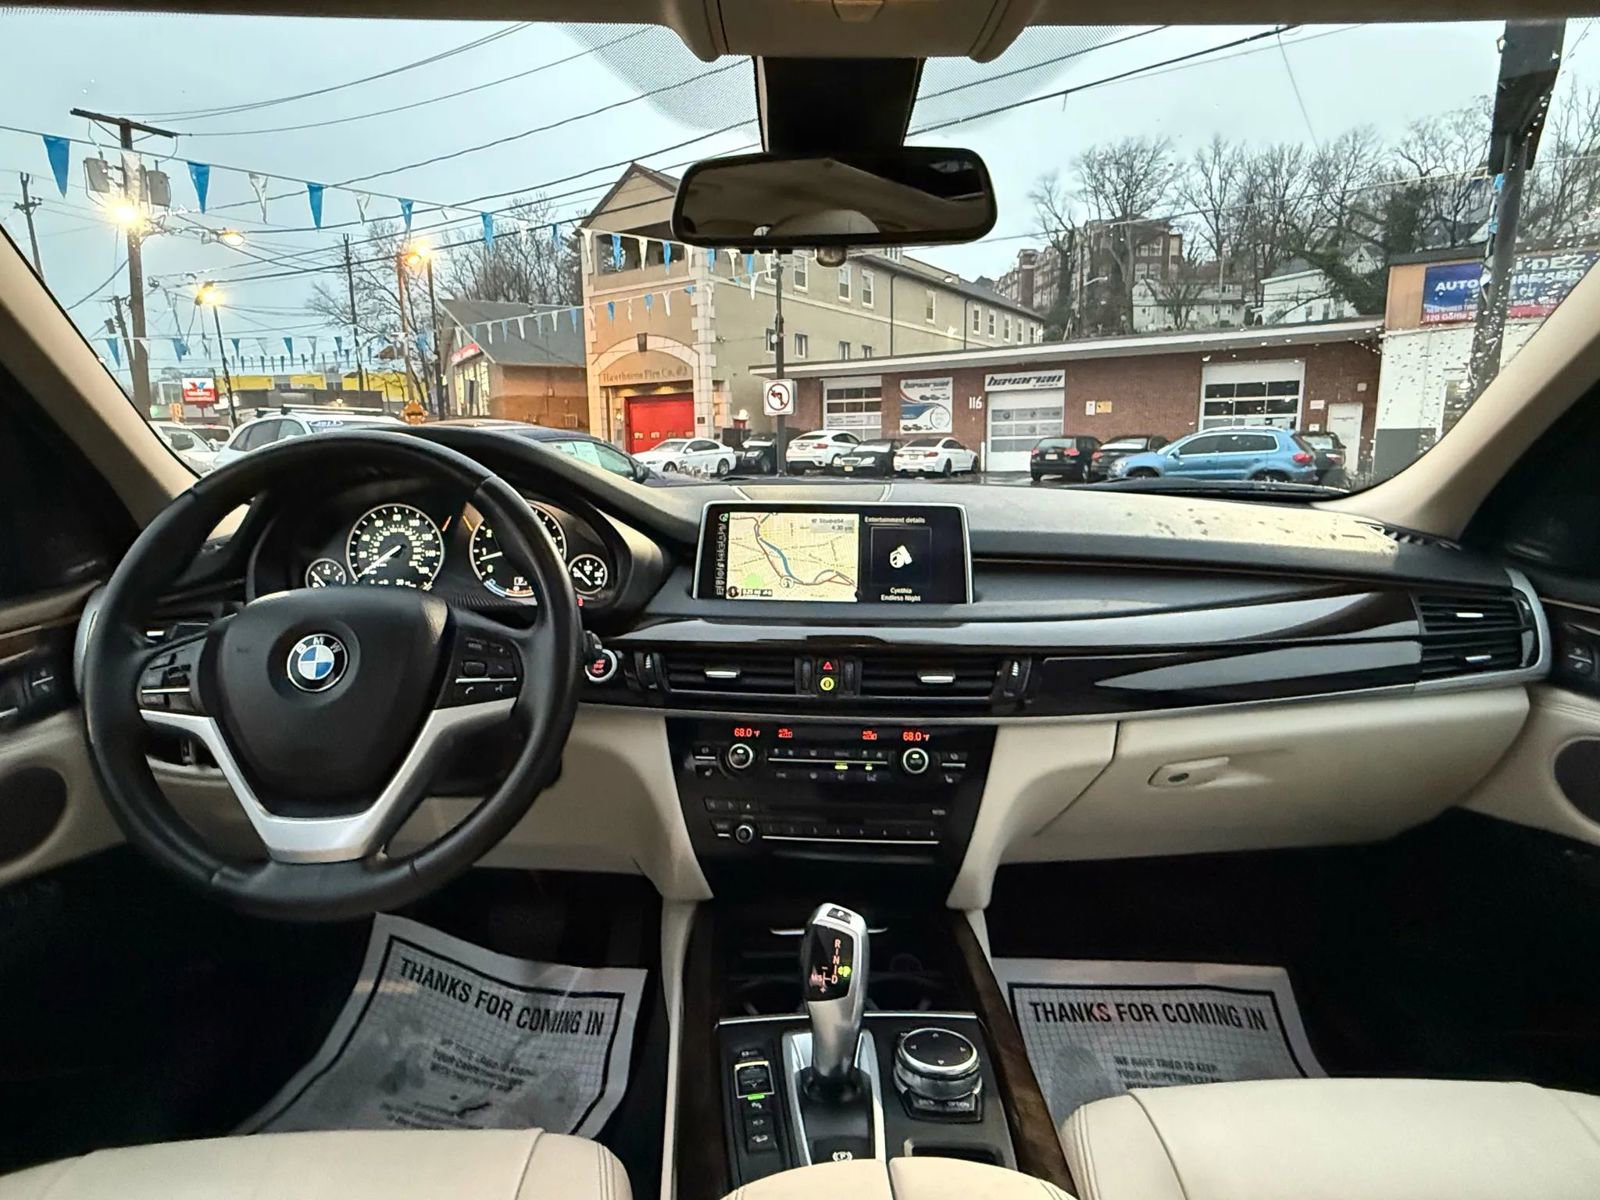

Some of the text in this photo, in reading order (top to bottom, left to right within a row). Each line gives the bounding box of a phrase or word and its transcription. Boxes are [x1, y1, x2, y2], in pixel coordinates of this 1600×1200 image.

[1434, 279, 1479, 291] AUTO
[968, 396, 983, 409] 116
[734, 728, 753, 738] 68.0
[902, 732, 922, 742] 68.0
[834, 938, 842, 948] R
[832, 955, 840, 965] N
[831, 974, 838, 984] D
[401, 956, 605, 1036] THANKS FOR COMING IN
[1029, 1001, 1268, 1031] THANKS FOR COMING IN
